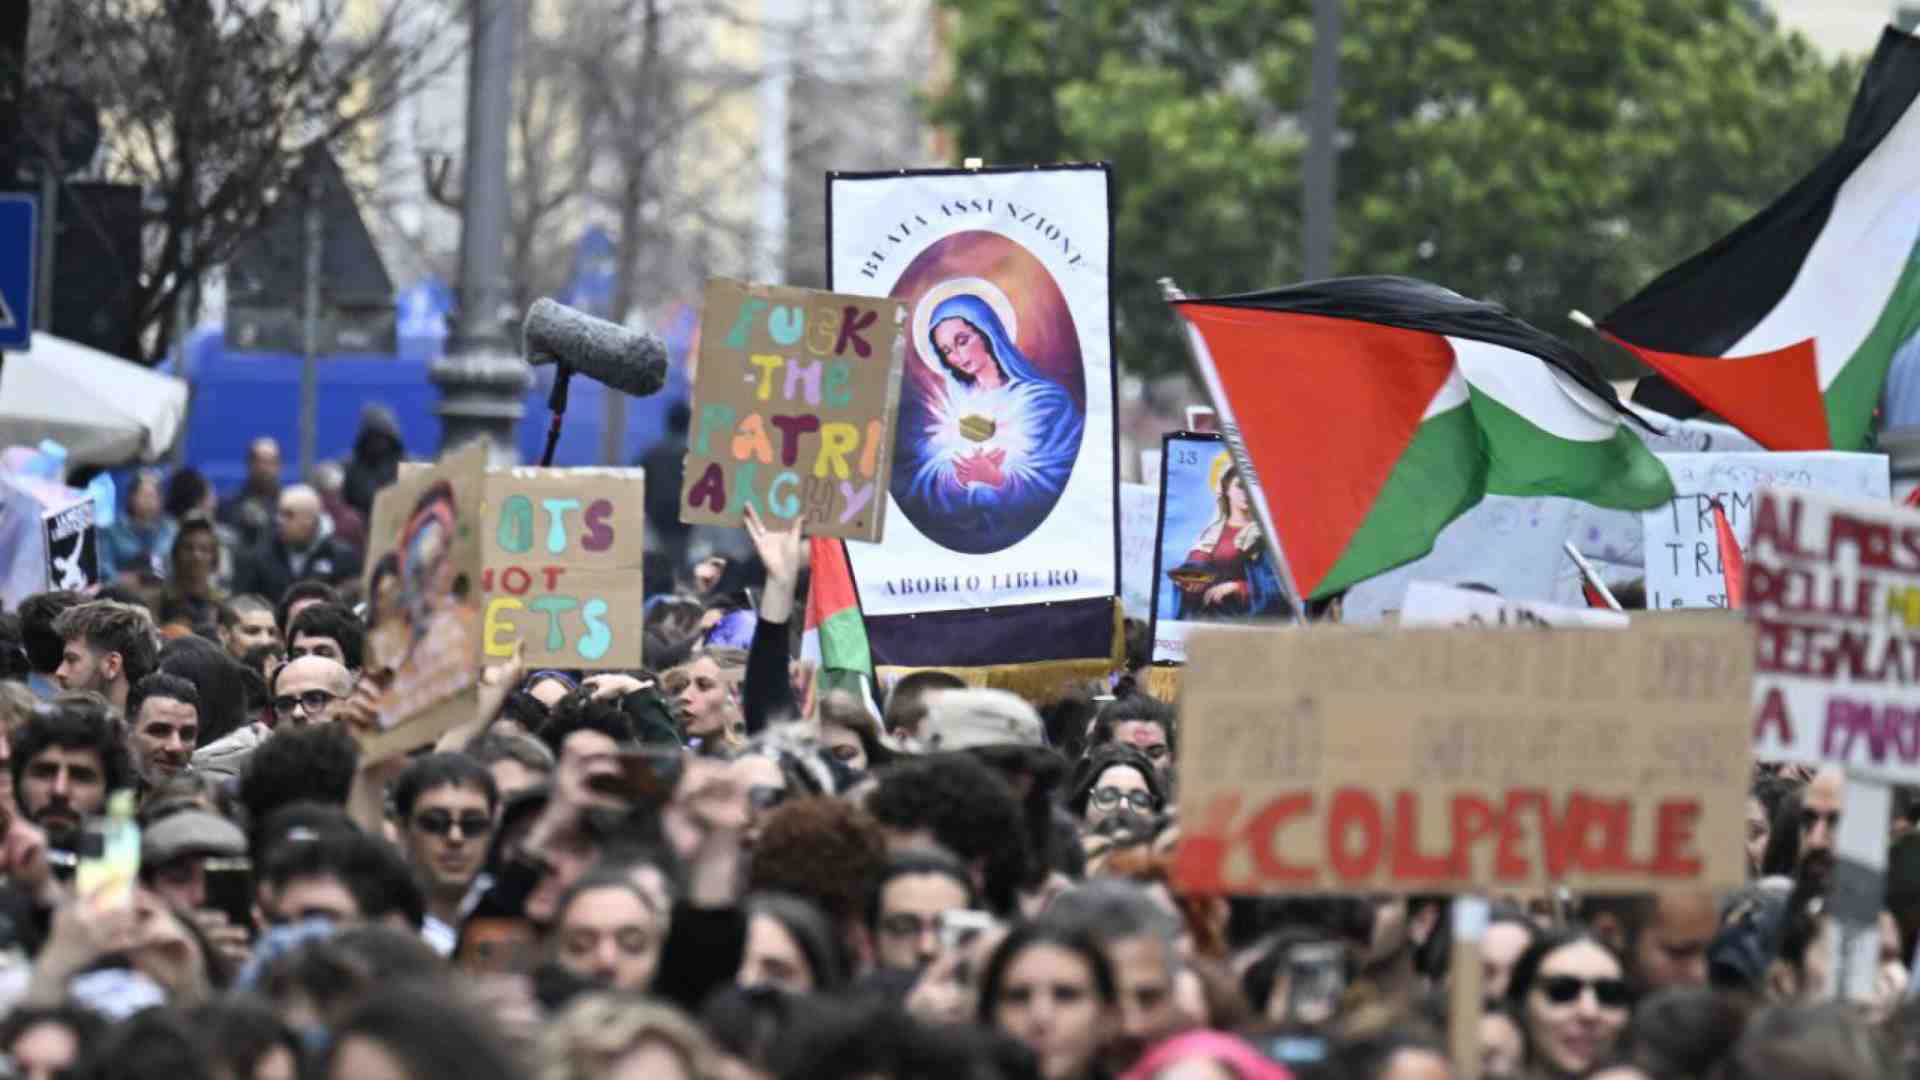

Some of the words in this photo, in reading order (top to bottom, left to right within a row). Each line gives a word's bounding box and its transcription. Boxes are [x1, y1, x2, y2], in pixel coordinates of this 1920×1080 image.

[861, 215, 928, 279] BEATA
[721, 296, 878, 357] FUCK
[697, 402, 881, 478] PATRI
[481, 494, 614, 553] OTS
[1671, 491, 1754, 535] TREM
[1828, 510, 1920, 573] POS
[882, 575, 981, 597] ABORTO
[991, 568, 1079, 591] LIBERO
[484, 595, 614, 662] ETS
[1248, 786, 1704, 884] COLPEVOLE
